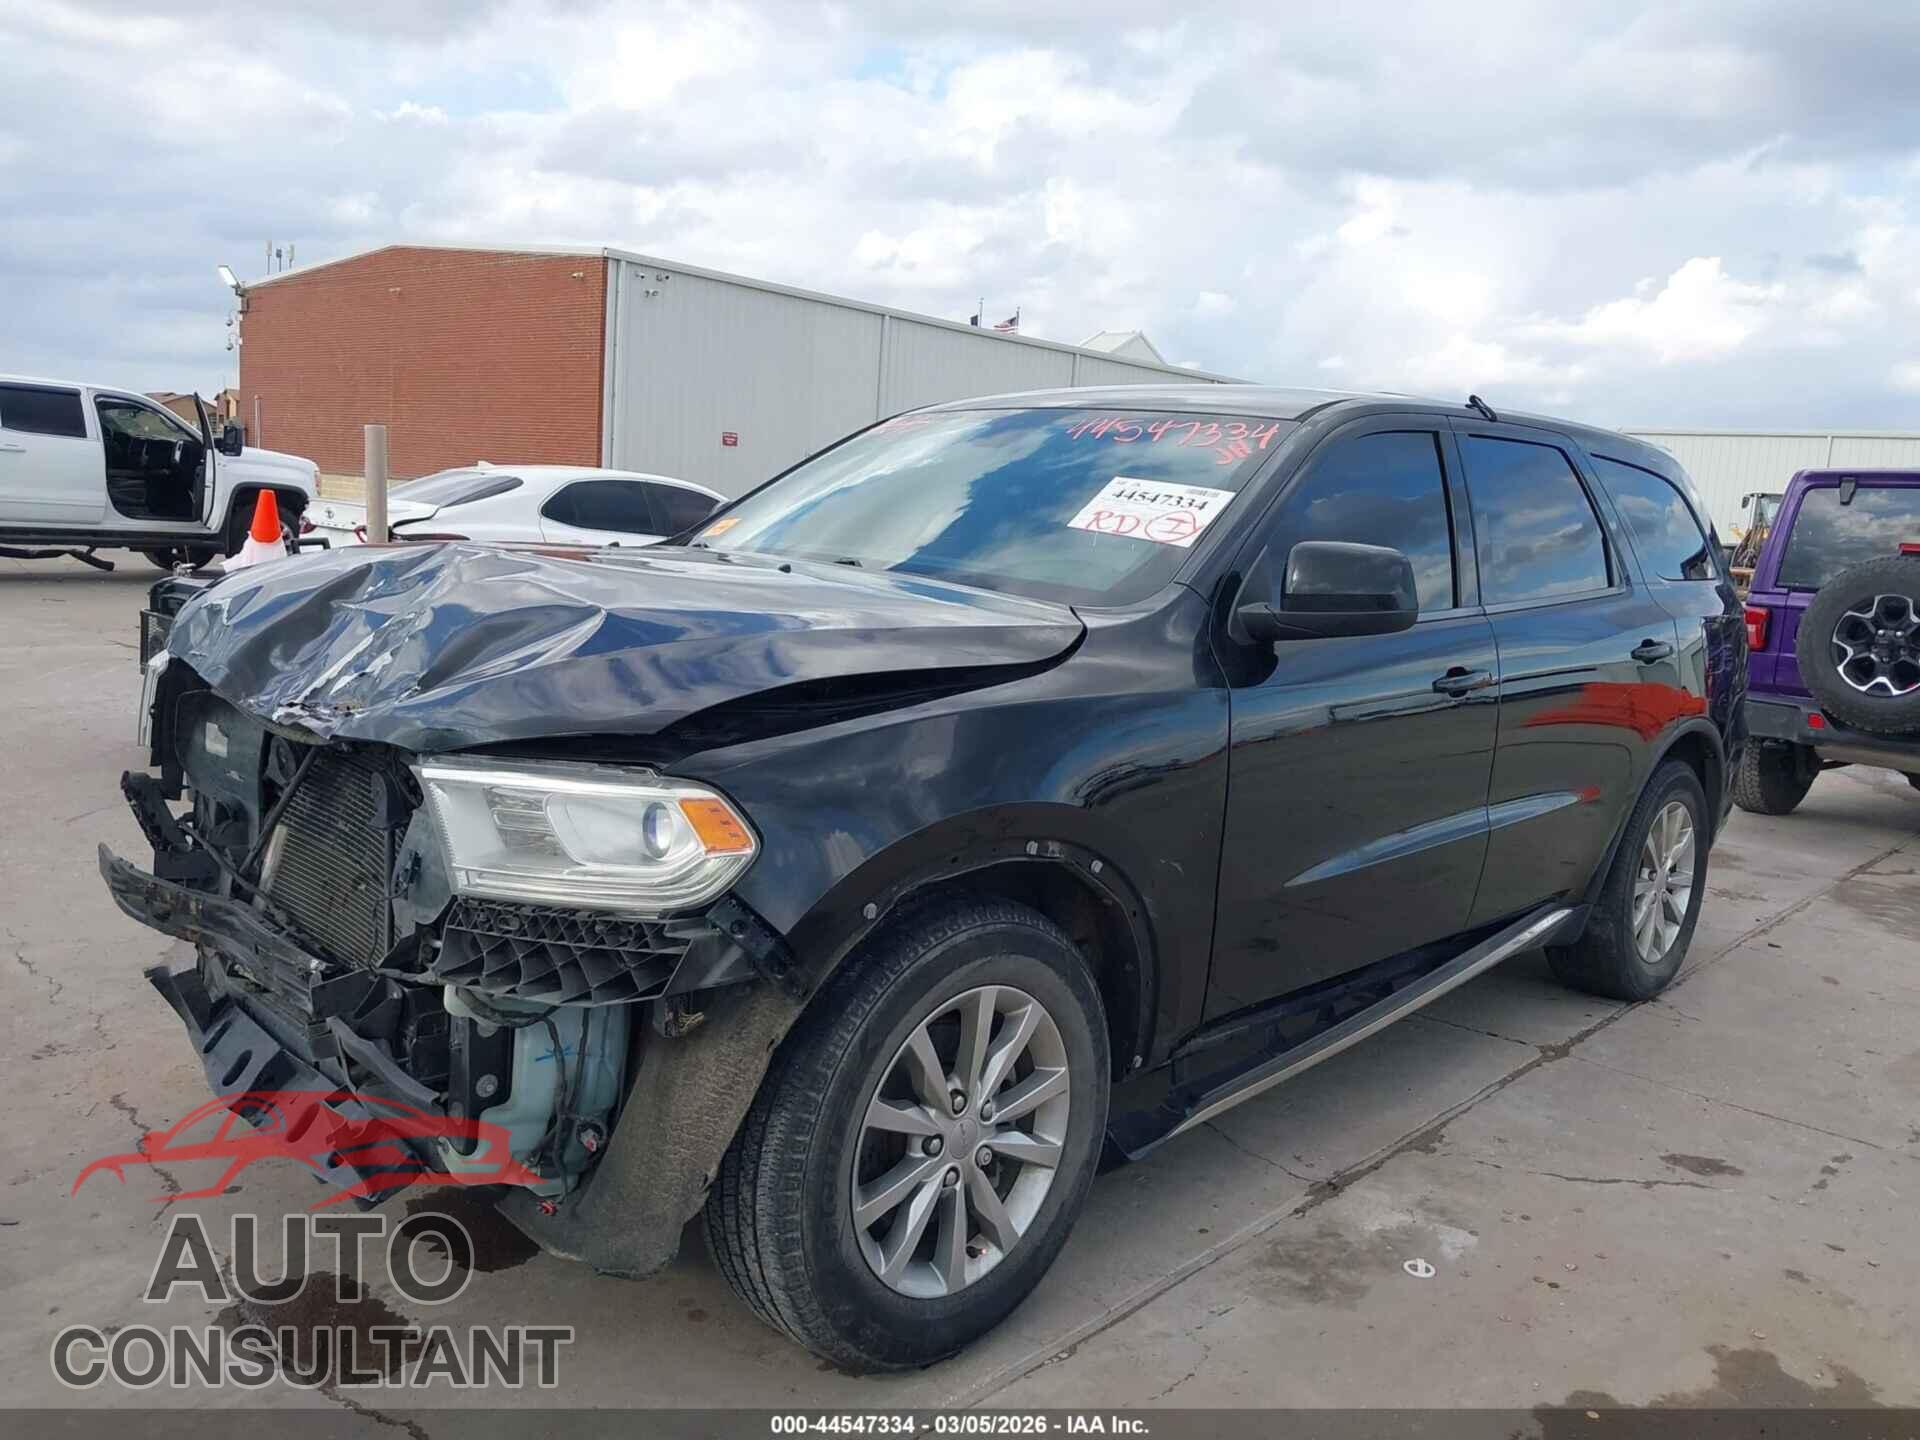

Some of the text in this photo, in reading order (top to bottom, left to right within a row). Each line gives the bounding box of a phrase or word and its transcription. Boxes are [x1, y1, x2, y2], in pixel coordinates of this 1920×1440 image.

[1066, 417, 1280, 449] 44547334
[1112, 489, 1209, 511] 44547334
[1085, 510, 1140, 534] RD
